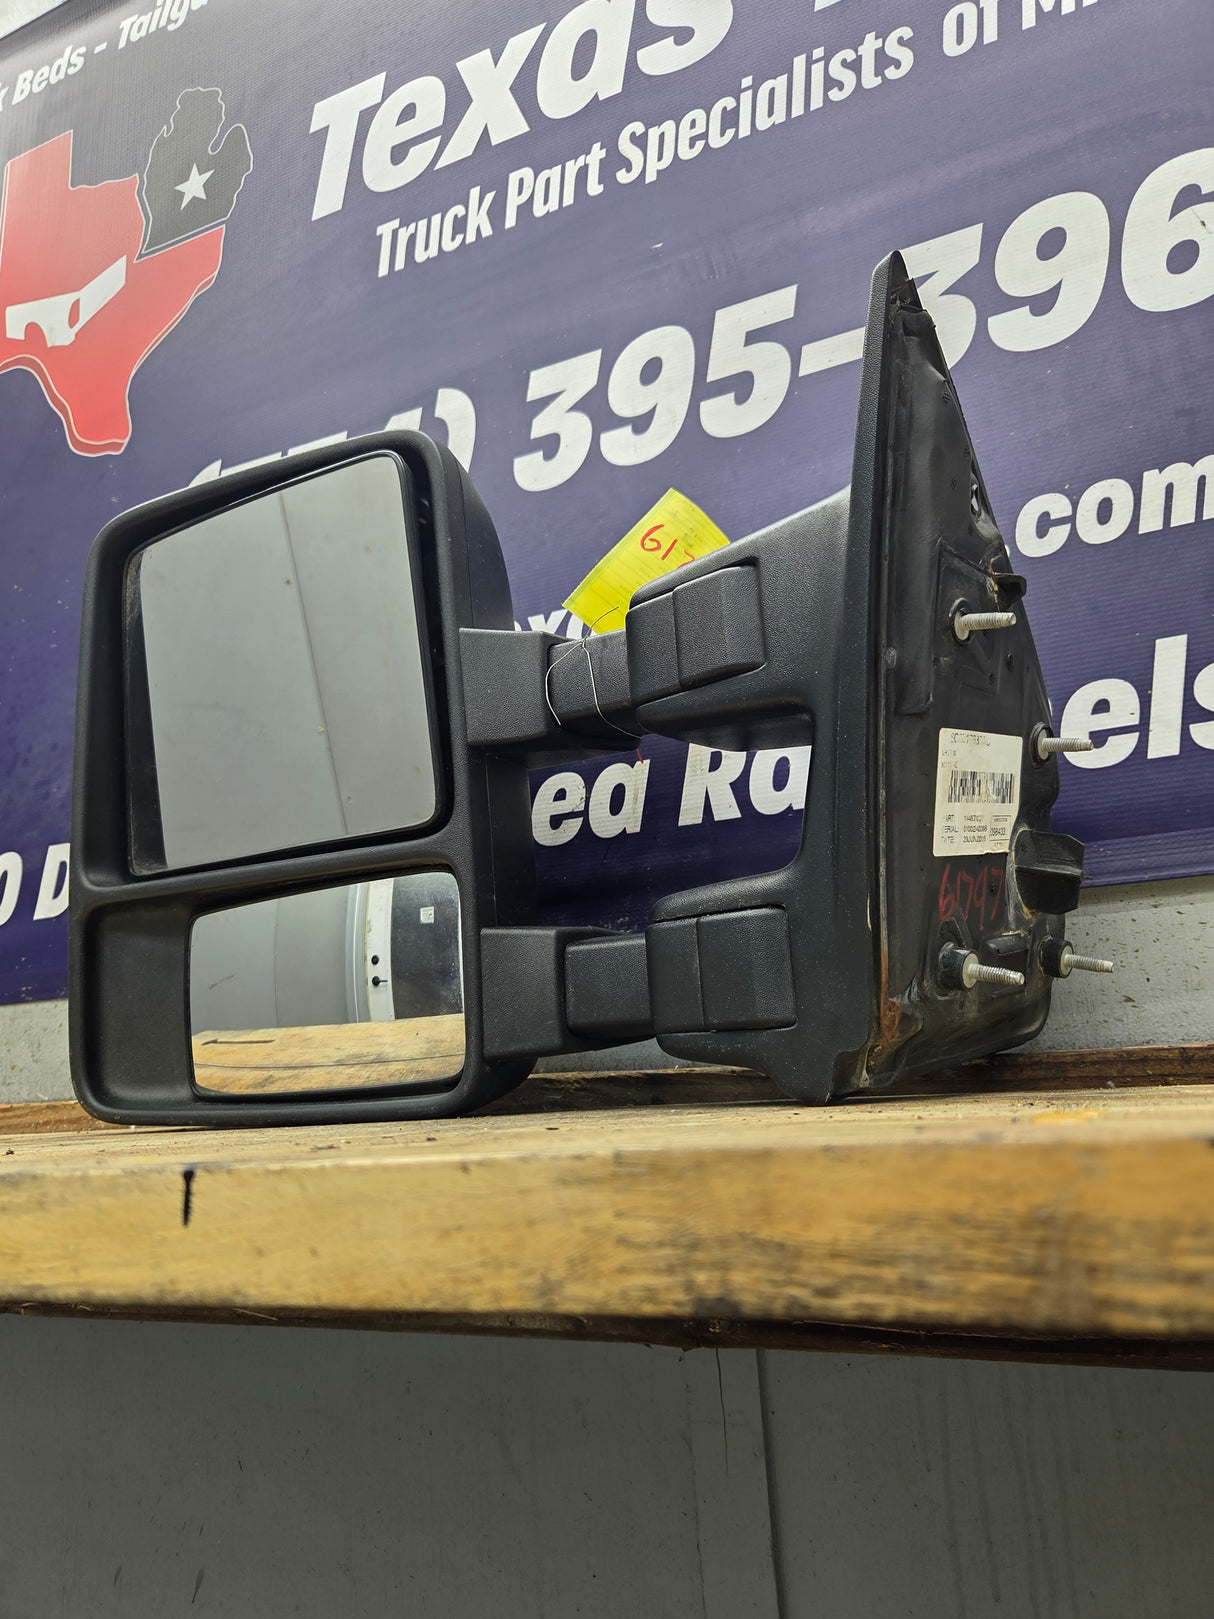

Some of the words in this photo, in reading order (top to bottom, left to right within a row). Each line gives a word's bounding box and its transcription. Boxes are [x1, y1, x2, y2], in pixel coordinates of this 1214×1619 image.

[11, 45, 87, 106] Beds
[309, 0, 733, 222] Texas
[376, 186, 496, 278] Truck
[505, 142, 606, 229] Part
[615, 26, 914, 185] Specialists
